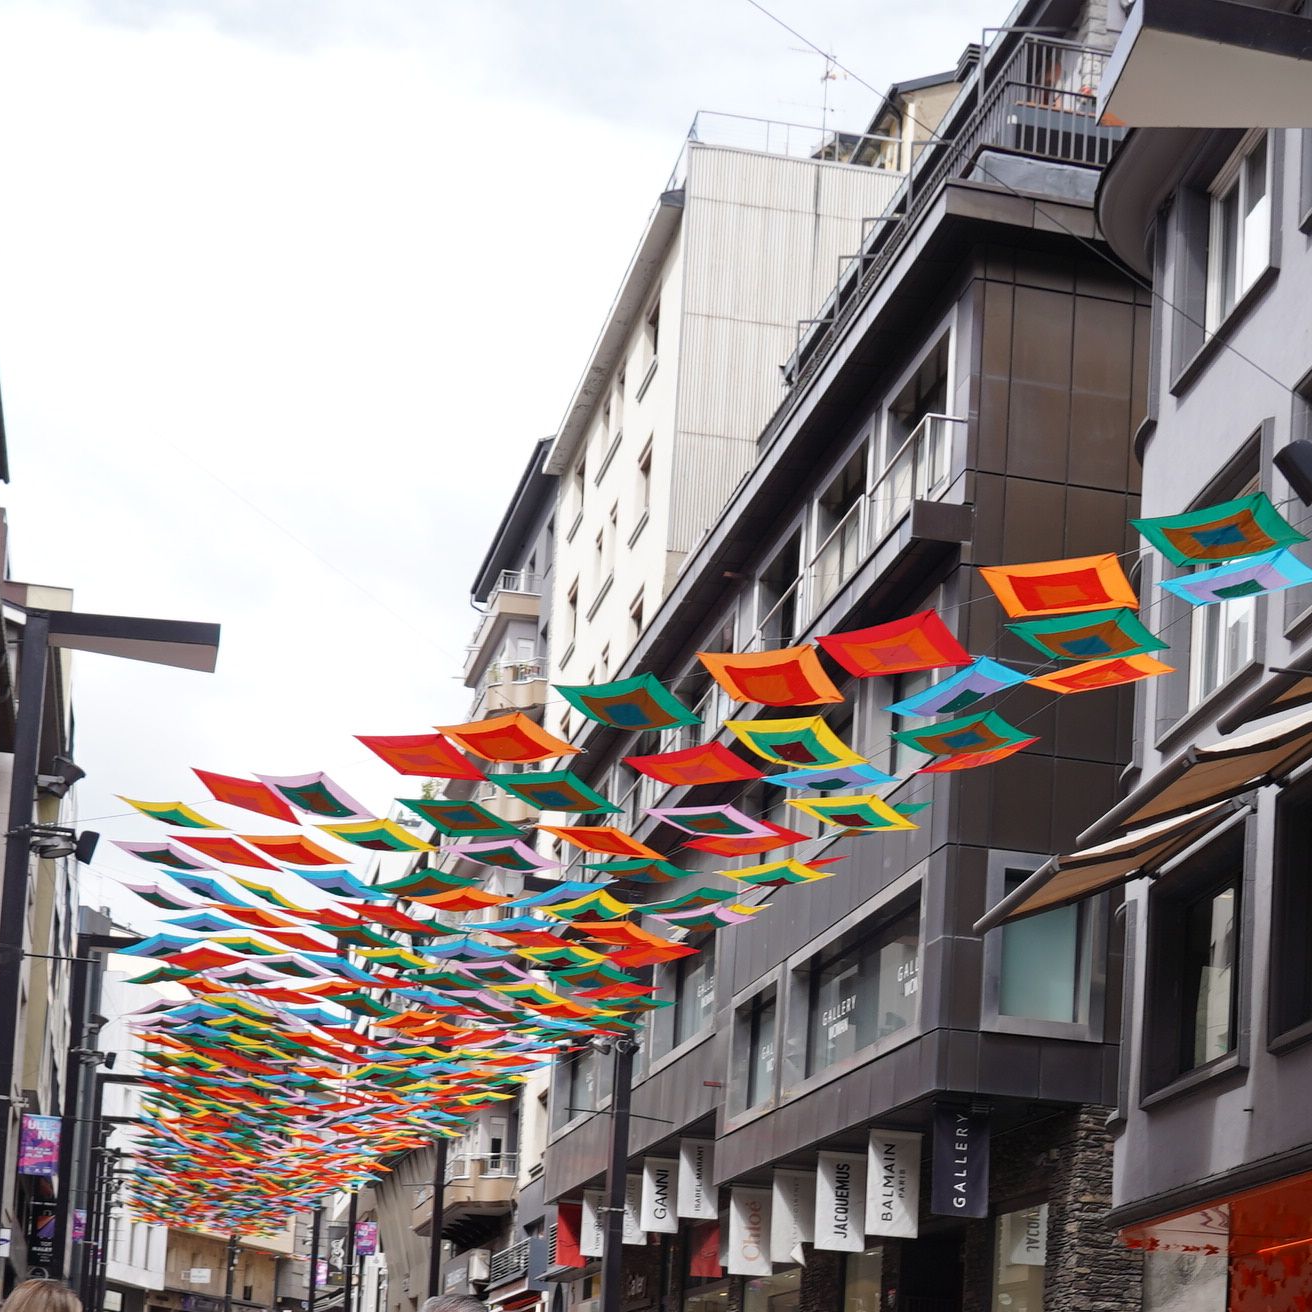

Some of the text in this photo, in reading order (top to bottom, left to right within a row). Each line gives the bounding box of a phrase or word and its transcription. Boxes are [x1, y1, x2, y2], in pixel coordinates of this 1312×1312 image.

[822, 993, 857, 1027] GALLERY
[881, 1143, 897, 1222] BALMAIN
[898, 1169, 907, 1199] PARIS
[952, 1113, 969, 1209] GALLERY
[653, 1169, 670, 1220] GANNI
[833, 1162, 851, 1239] JACQUEMUS
[742, 1200, 762, 1262] Chloé
